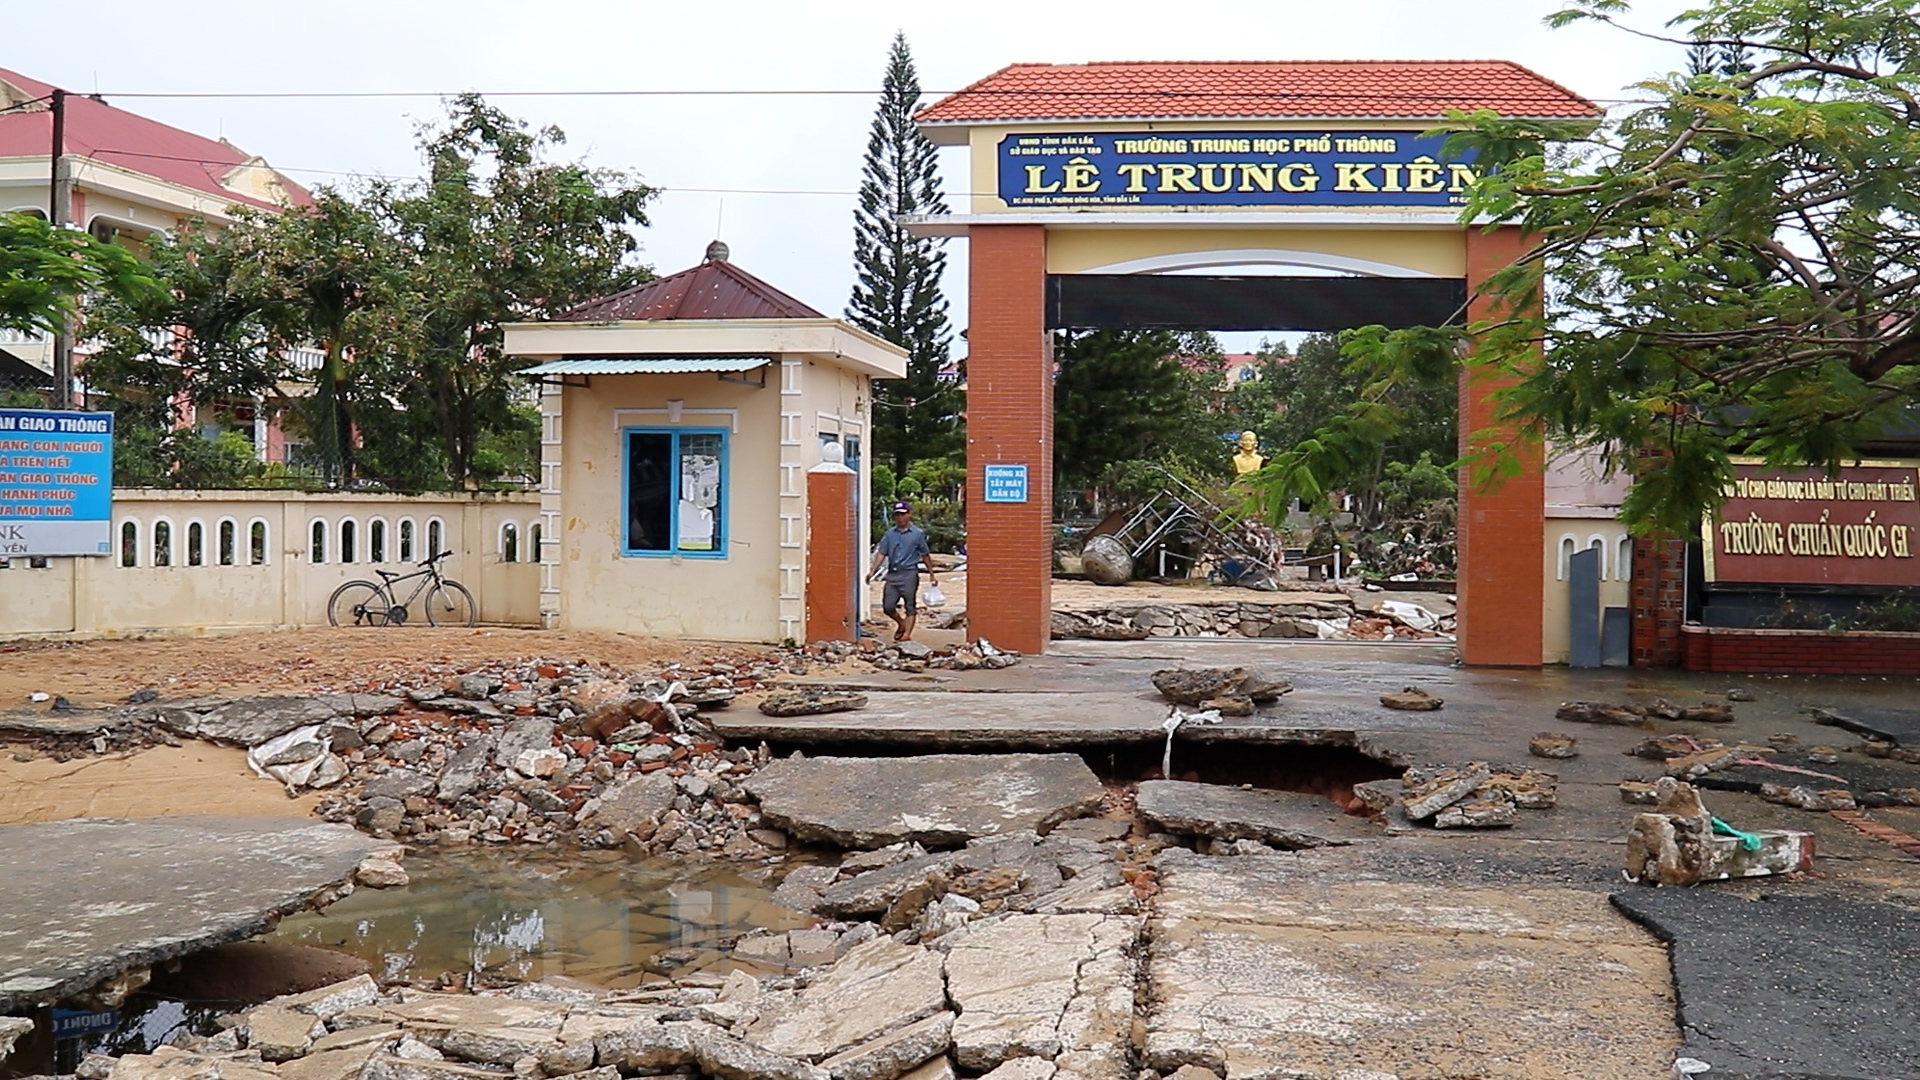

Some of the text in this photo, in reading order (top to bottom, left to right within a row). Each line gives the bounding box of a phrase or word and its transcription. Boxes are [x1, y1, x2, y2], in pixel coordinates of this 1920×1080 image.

[1114, 137, 1187, 154] TRƯỜNG
[1191, 139, 1249, 153] TRUNG
[1253, 139, 1290, 156] HỌC
[1335, 136, 1396, 153] THÔNG
[1024, 156, 1483, 193] LÊ TRUNG KIÊN
[19, 417, 56, 432] GIAO
[58, 417, 108, 433] THÔNG
[33, 441, 60, 451] CON
[13, 456, 45, 468] TRÊN
[20, 473, 52, 484] GIAO
[55, 473, 98, 485] THÔNG
[1749, 480, 1766, 499] CHO
[1767, 476, 1787, 499] GIÁO
[1787, 481, 1805, 503] DỤC
[1805, 477, 1817, 500] LÀ
[1835, 479, 1848, 500] TƯ
[1848, 483, 1866, 500] CHO
[1866, 479, 1887, 501] PHÁT
[1889, 475, 1915, 501] TRIỂN
[16, 506, 42, 518] MỌI
[46, 504, 73, 516] NHÀ
[1720, 508, 1914, 558] TRƯỜNG CHUẨN QUỐC GI
[3, 543, 28, 553] YÊN
